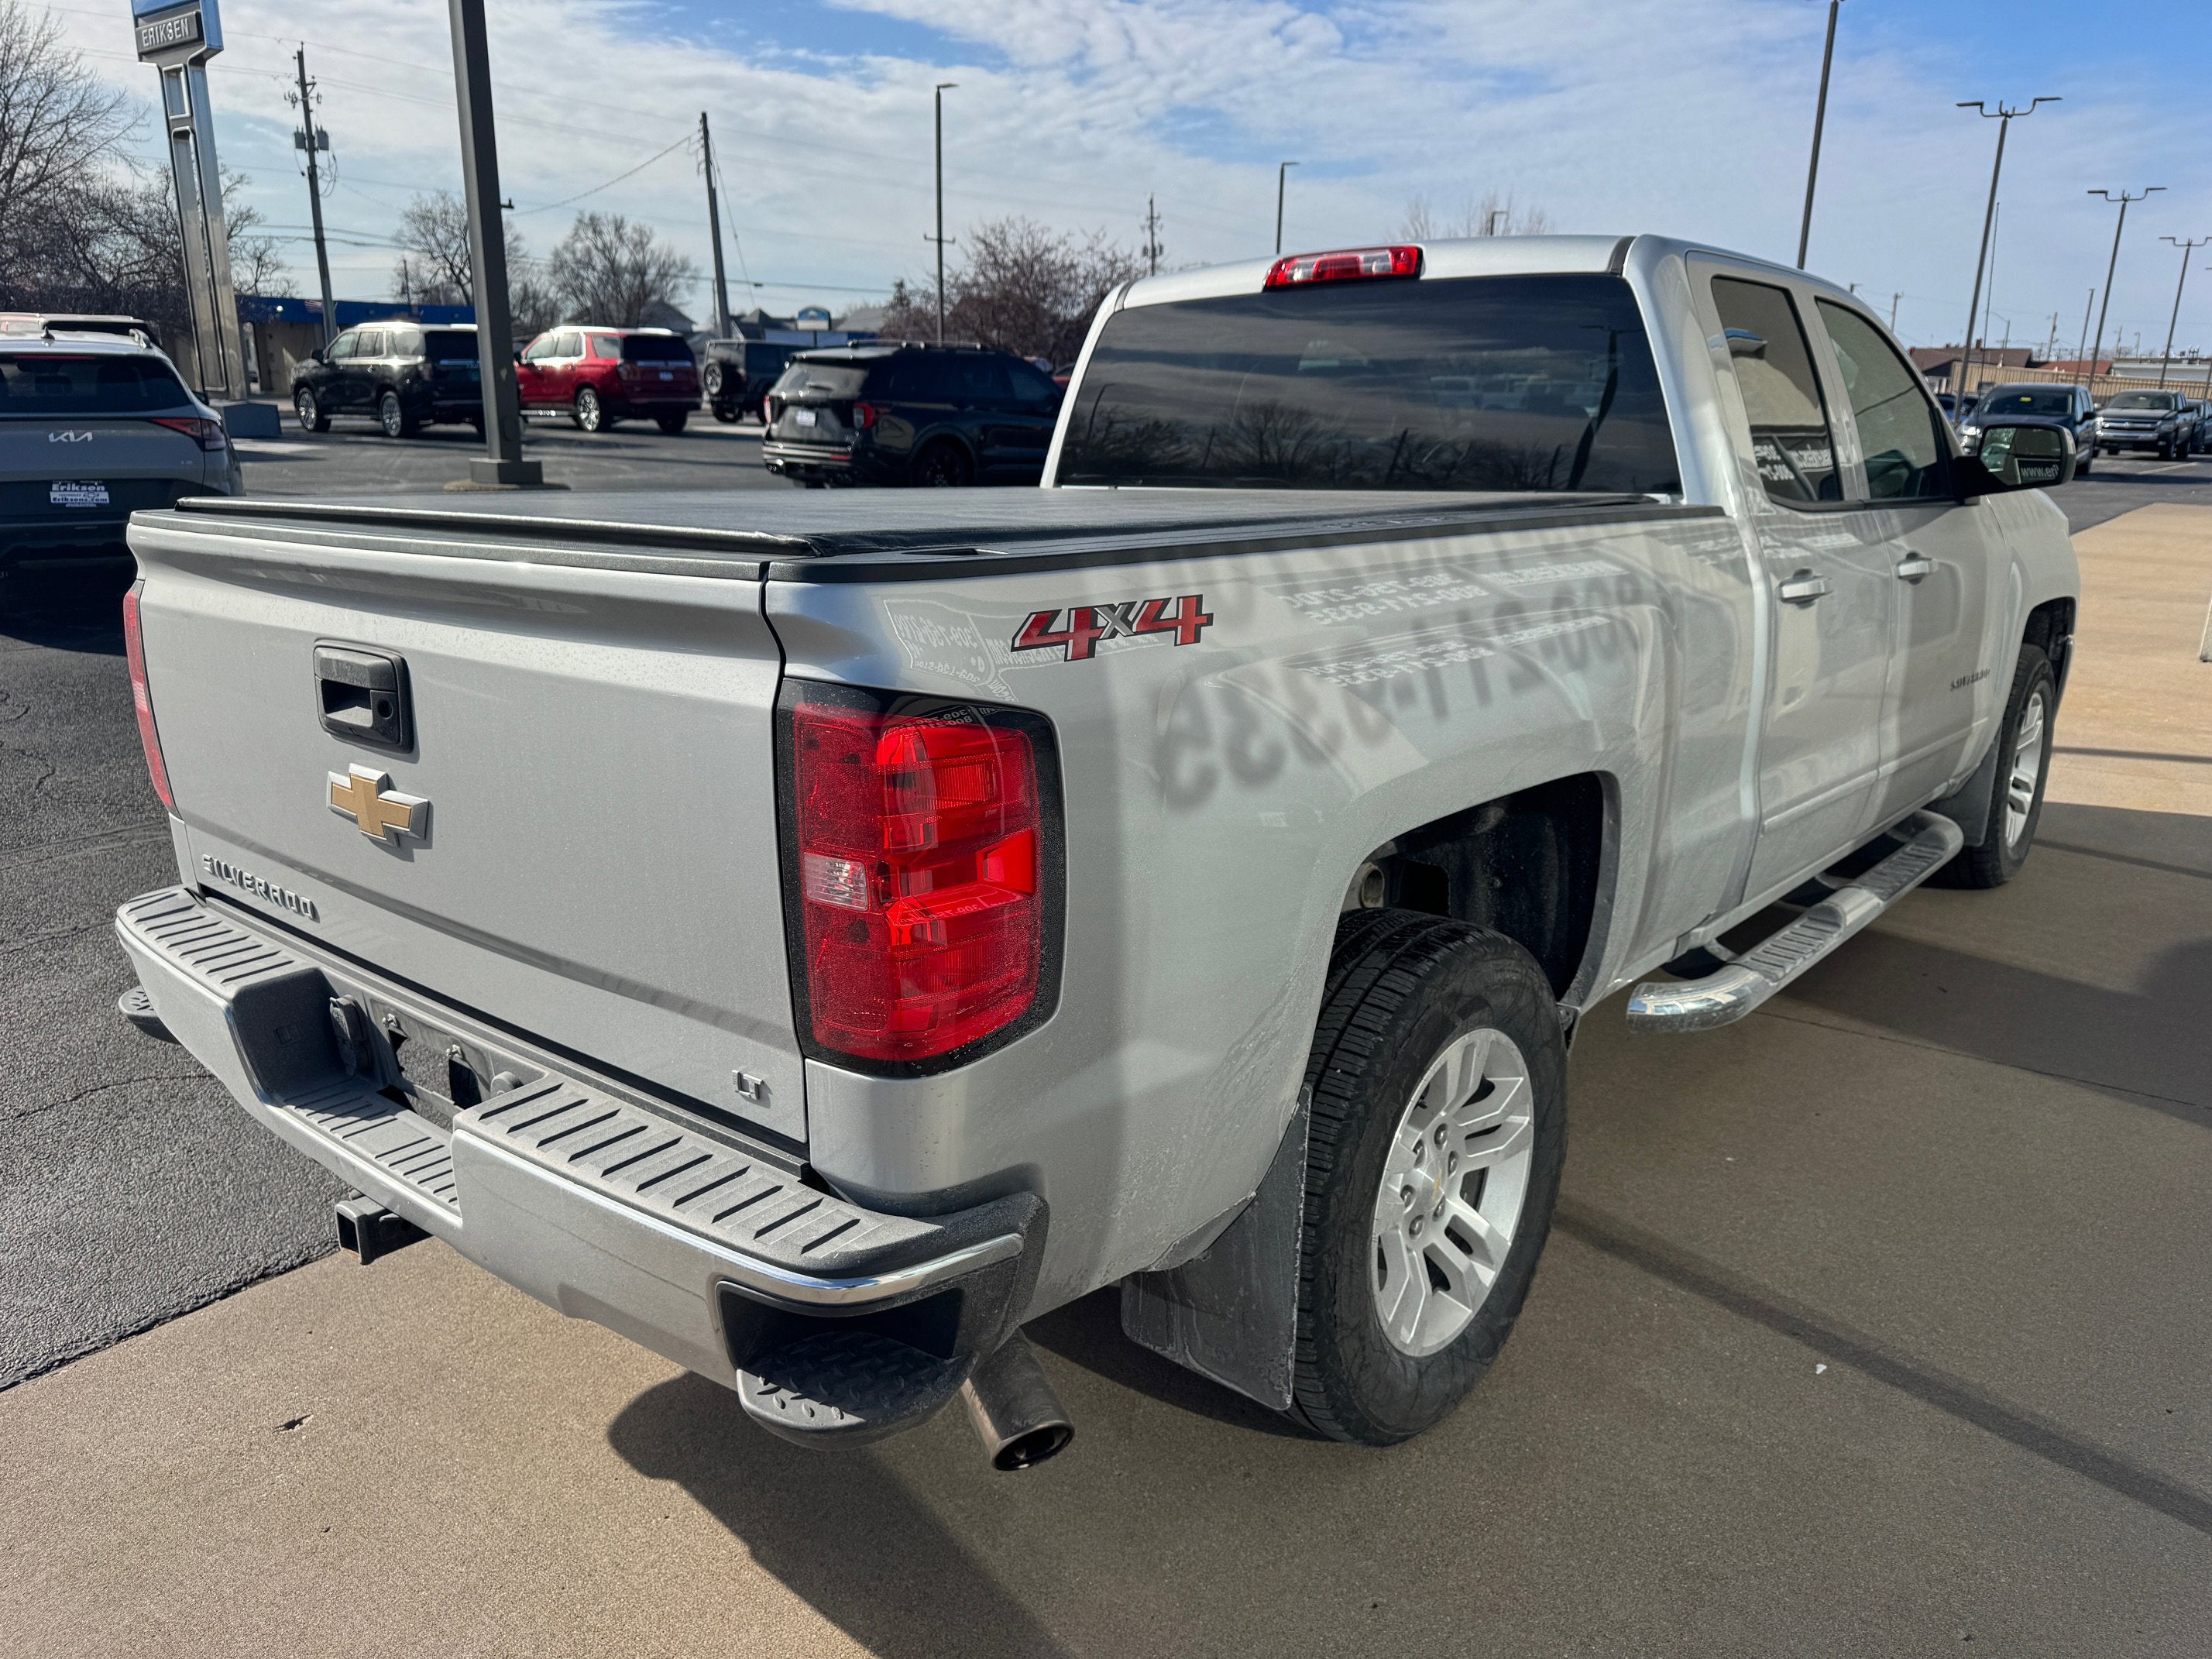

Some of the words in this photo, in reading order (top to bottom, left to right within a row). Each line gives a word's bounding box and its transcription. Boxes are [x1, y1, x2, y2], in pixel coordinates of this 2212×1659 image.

[142, 17, 190, 47] ERIKSEN
[202, 854, 317, 922] SILVERADO
[731, 1070, 764, 1100] LT
